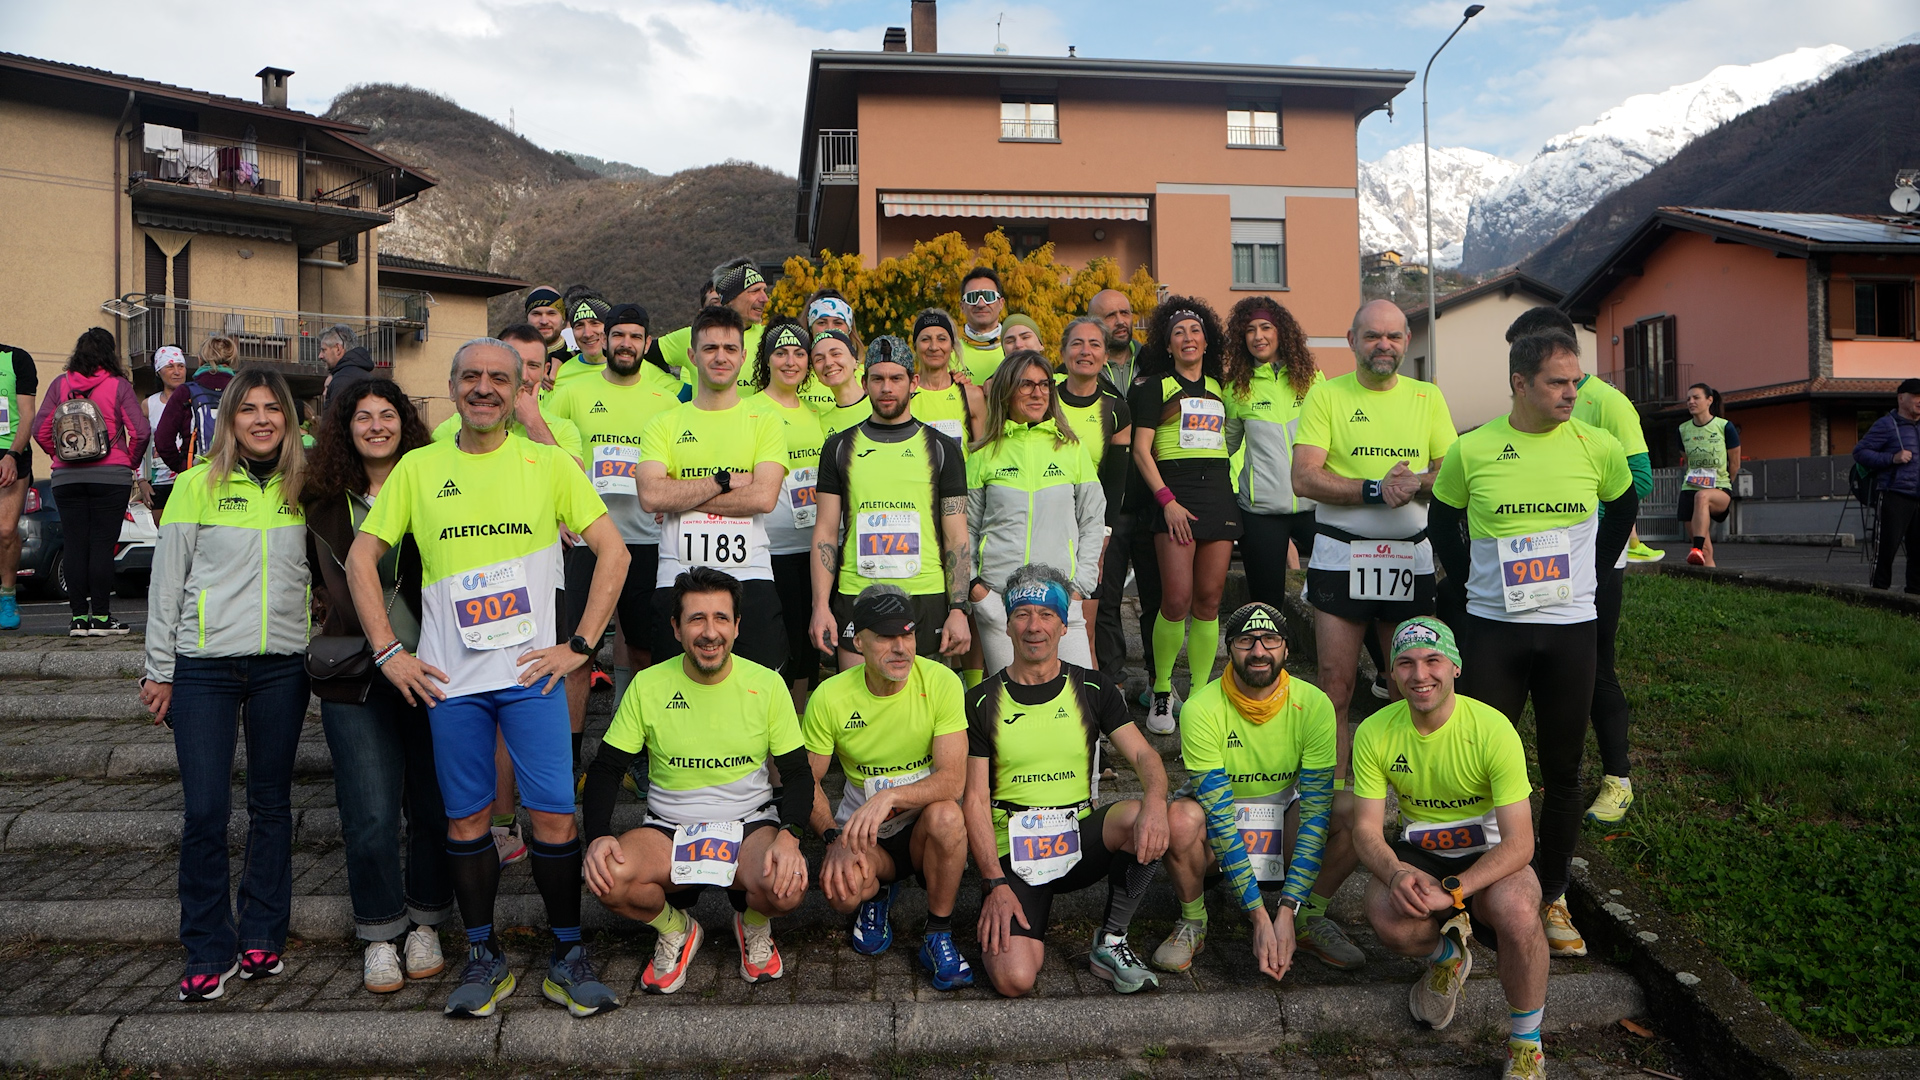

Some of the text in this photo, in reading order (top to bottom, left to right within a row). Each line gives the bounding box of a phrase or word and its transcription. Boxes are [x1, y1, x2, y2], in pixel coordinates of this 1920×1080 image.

[744, 274, 765, 289] CIMA
[573, 310, 598, 322] CIMA
[775, 336, 802, 348] CIMA
[1188, 414, 1219, 432] 842
[1350, 415, 1370, 423] CIMA
[590, 434, 641, 445] ATLETICACI
[676, 436, 698, 445] CIMA
[788, 447, 821, 460] TLETICAC
[1351, 446, 1420, 458] ATLETICACIMA
[1496, 452, 1520, 461] CIMA
[601, 460, 637, 478] 876
[1043, 469, 1065, 477] CIMA
[436, 487, 462, 498] CIMA
[797, 486, 817, 506] 90
[859, 501, 917, 510] ATLETICACIMA
[1494, 502, 1587, 515] ATLETICACIMA
[439, 522, 533, 540] ATLETICACIMA
[684, 533, 747, 564] 1183
[868, 534, 910, 555] 174
[1512, 557, 1561, 583] 904
[1357, 567, 1413, 596] 1179
[465, 592, 519, 624] 902
[1241, 620, 1279, 632] CIMA
[666, 701, 690, 709] CIMA
[844, 720, 868, 729] CIMA
[1227, 739, 1243, 748] IMA
[668, 756, 754, 769] ATLETICACIMA
[1390, 764, 1413, 774] CIMA
[1011, 771, 1076, 783] ATLETICACIMA
[1401, 794, 1485, 809] ATLETICACIMA
[1243, 830, 1273, 853] 97
[1421, 828, 1472, 850] 683
[687, 839, 731, 861] 146
[1024, 834, 1069, 859] 156
